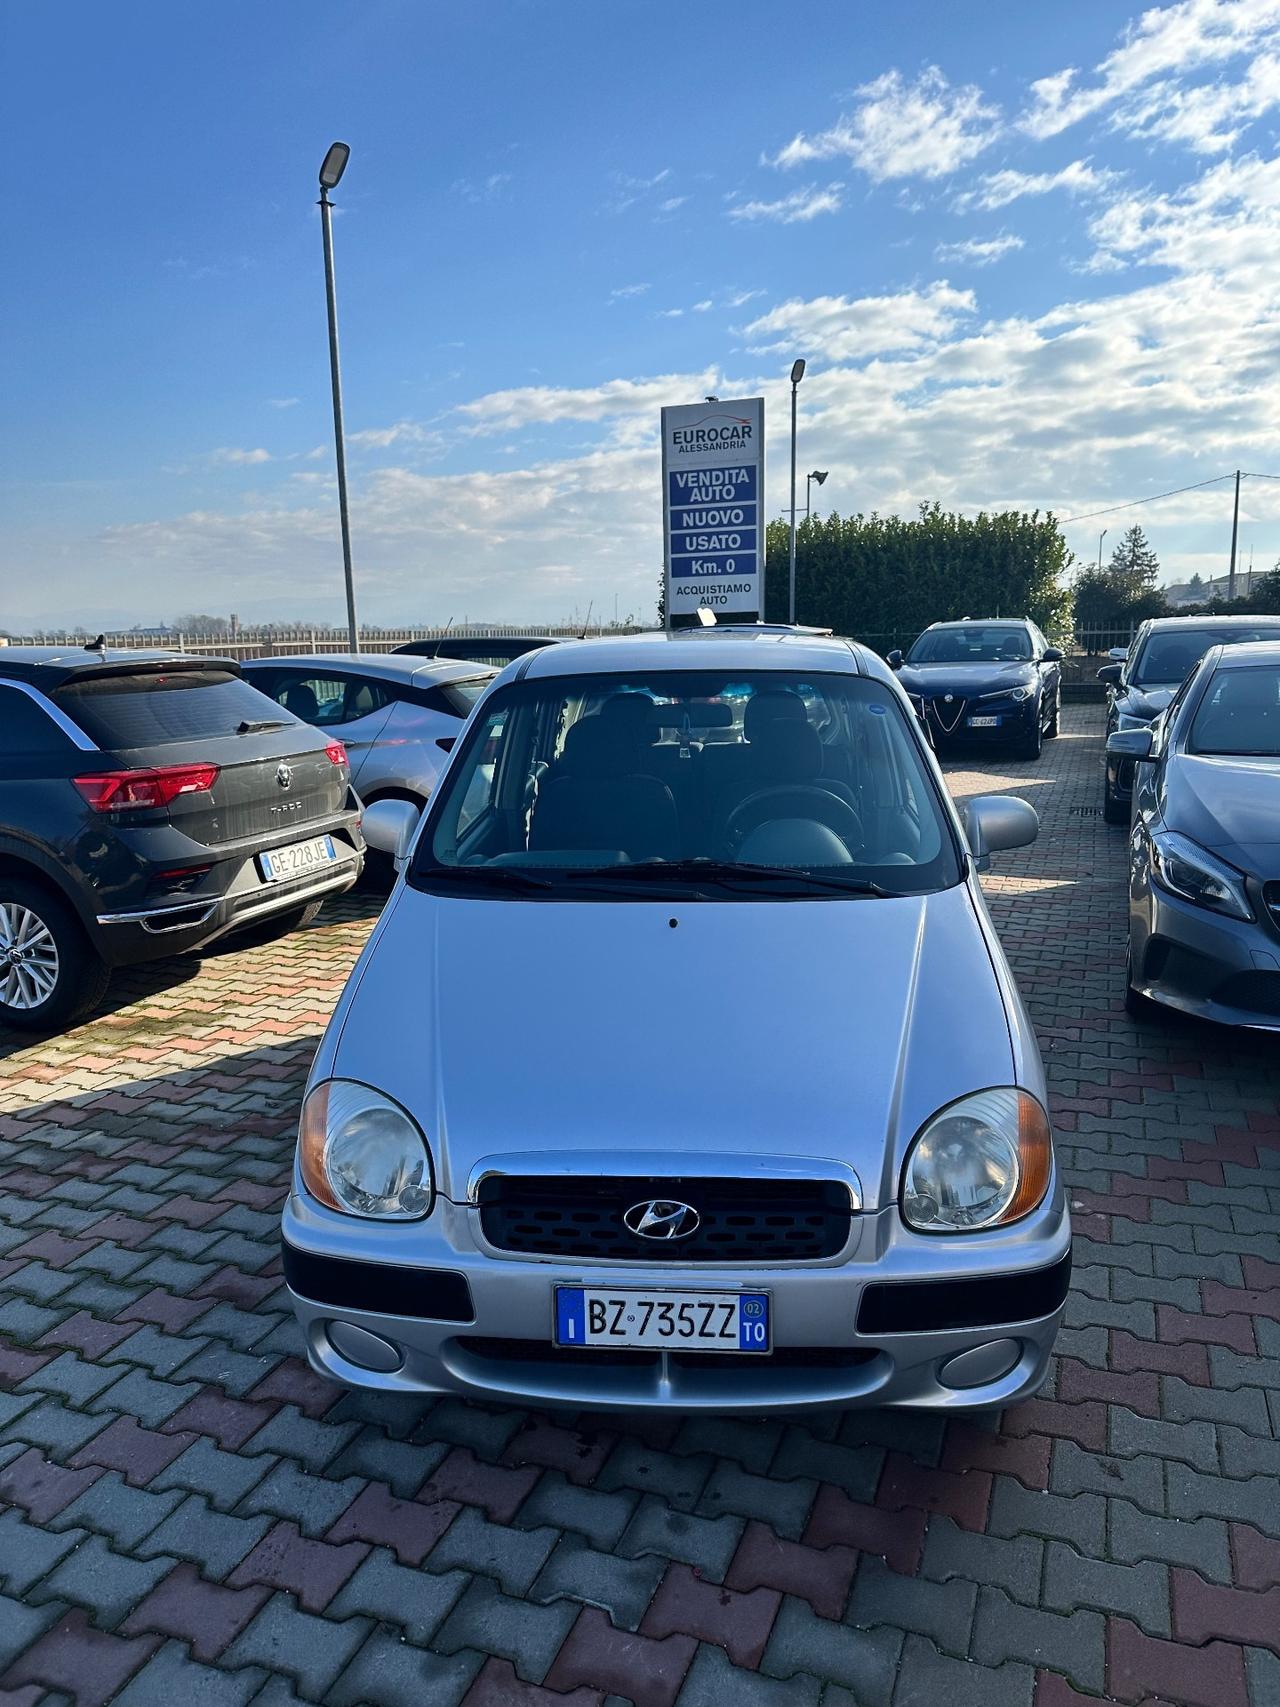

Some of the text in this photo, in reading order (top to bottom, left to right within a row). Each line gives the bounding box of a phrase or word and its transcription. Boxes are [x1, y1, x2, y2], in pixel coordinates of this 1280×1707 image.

[673, 426, 753, 445] EUROCAR
[678, 440, 747, 454] ALESSANDRIA
[676, 468, 750, 488] VENDITA
[690, 484, 736, 502] AUTO
[682, 508, 744, 527] NUOVO
[685, 533, 741, 551] USATO
[691, 558, 736, 574] Km. 0
[676, 583, 752, 596] ACQUISTIAMO
[700, 595, 728, 605] AUTO
[746, 1303, 760, 1315] 02
[742, 1321, 766, 1343] TO
